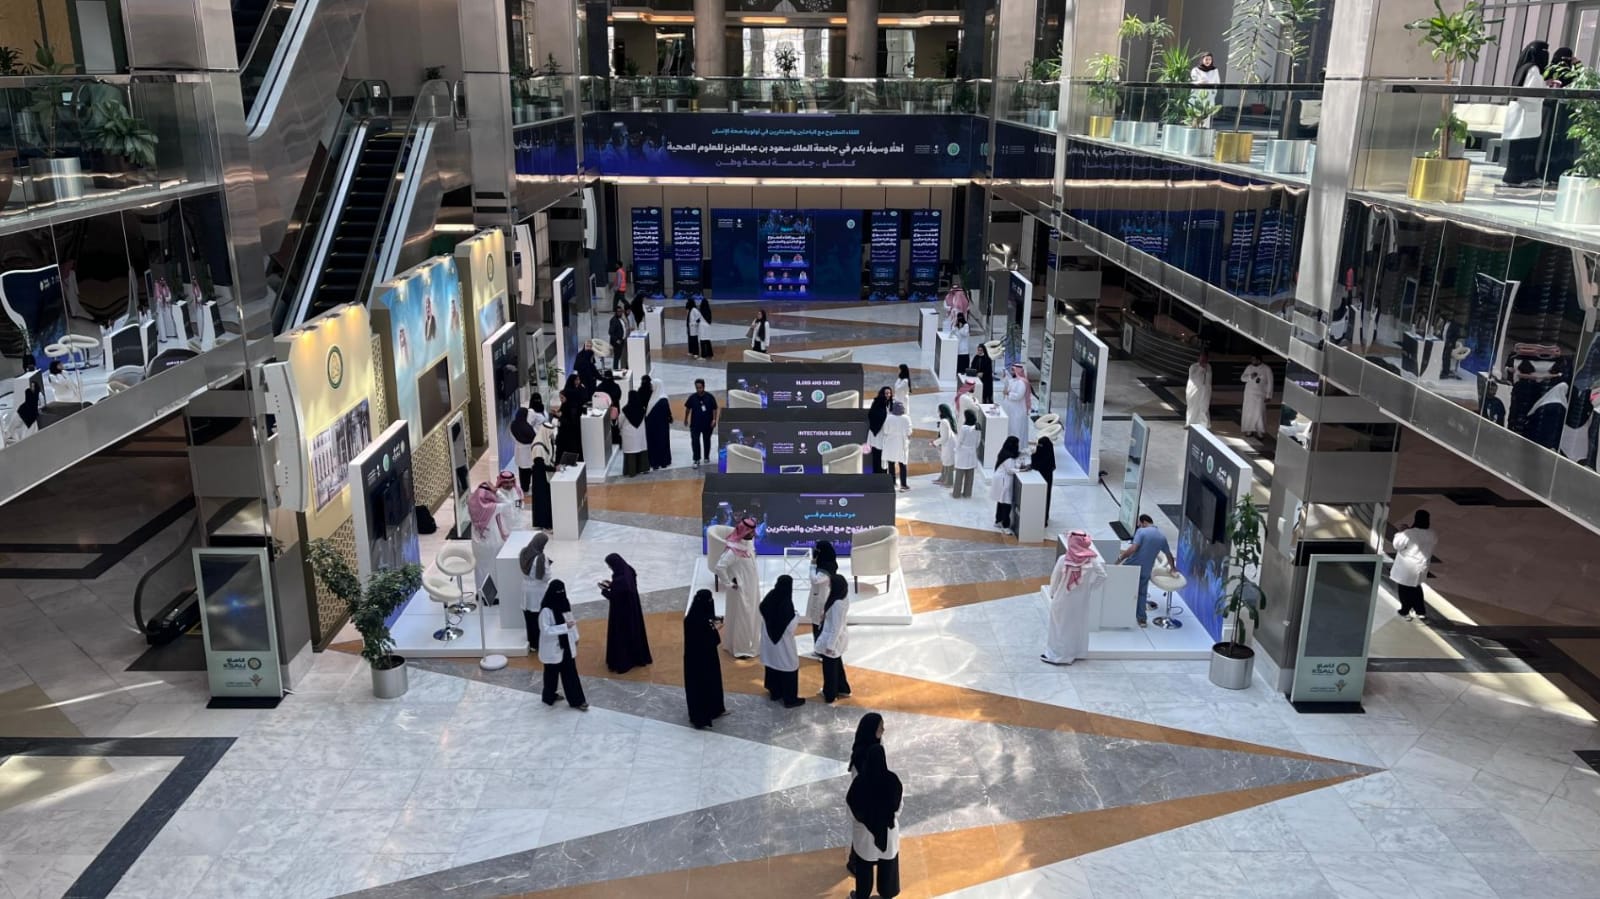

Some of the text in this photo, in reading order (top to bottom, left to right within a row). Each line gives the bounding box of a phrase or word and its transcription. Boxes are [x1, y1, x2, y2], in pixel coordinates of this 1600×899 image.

[667, 141, 696, 153] الصحية
[697, 143, 723, 153] للعلوم
[769, 145, 791, 154] سعود
[792, 144, 813, 152] الملك
[814, 143, 838, 154] جامعة
[839, 143, 850, 156] في
[851, 144, 866, 154] بكم
[766, 525, 804, 534] والمبتكرين
[805, 524, 833, 534] الباحثين
[834, 526, 844, 534] مع
